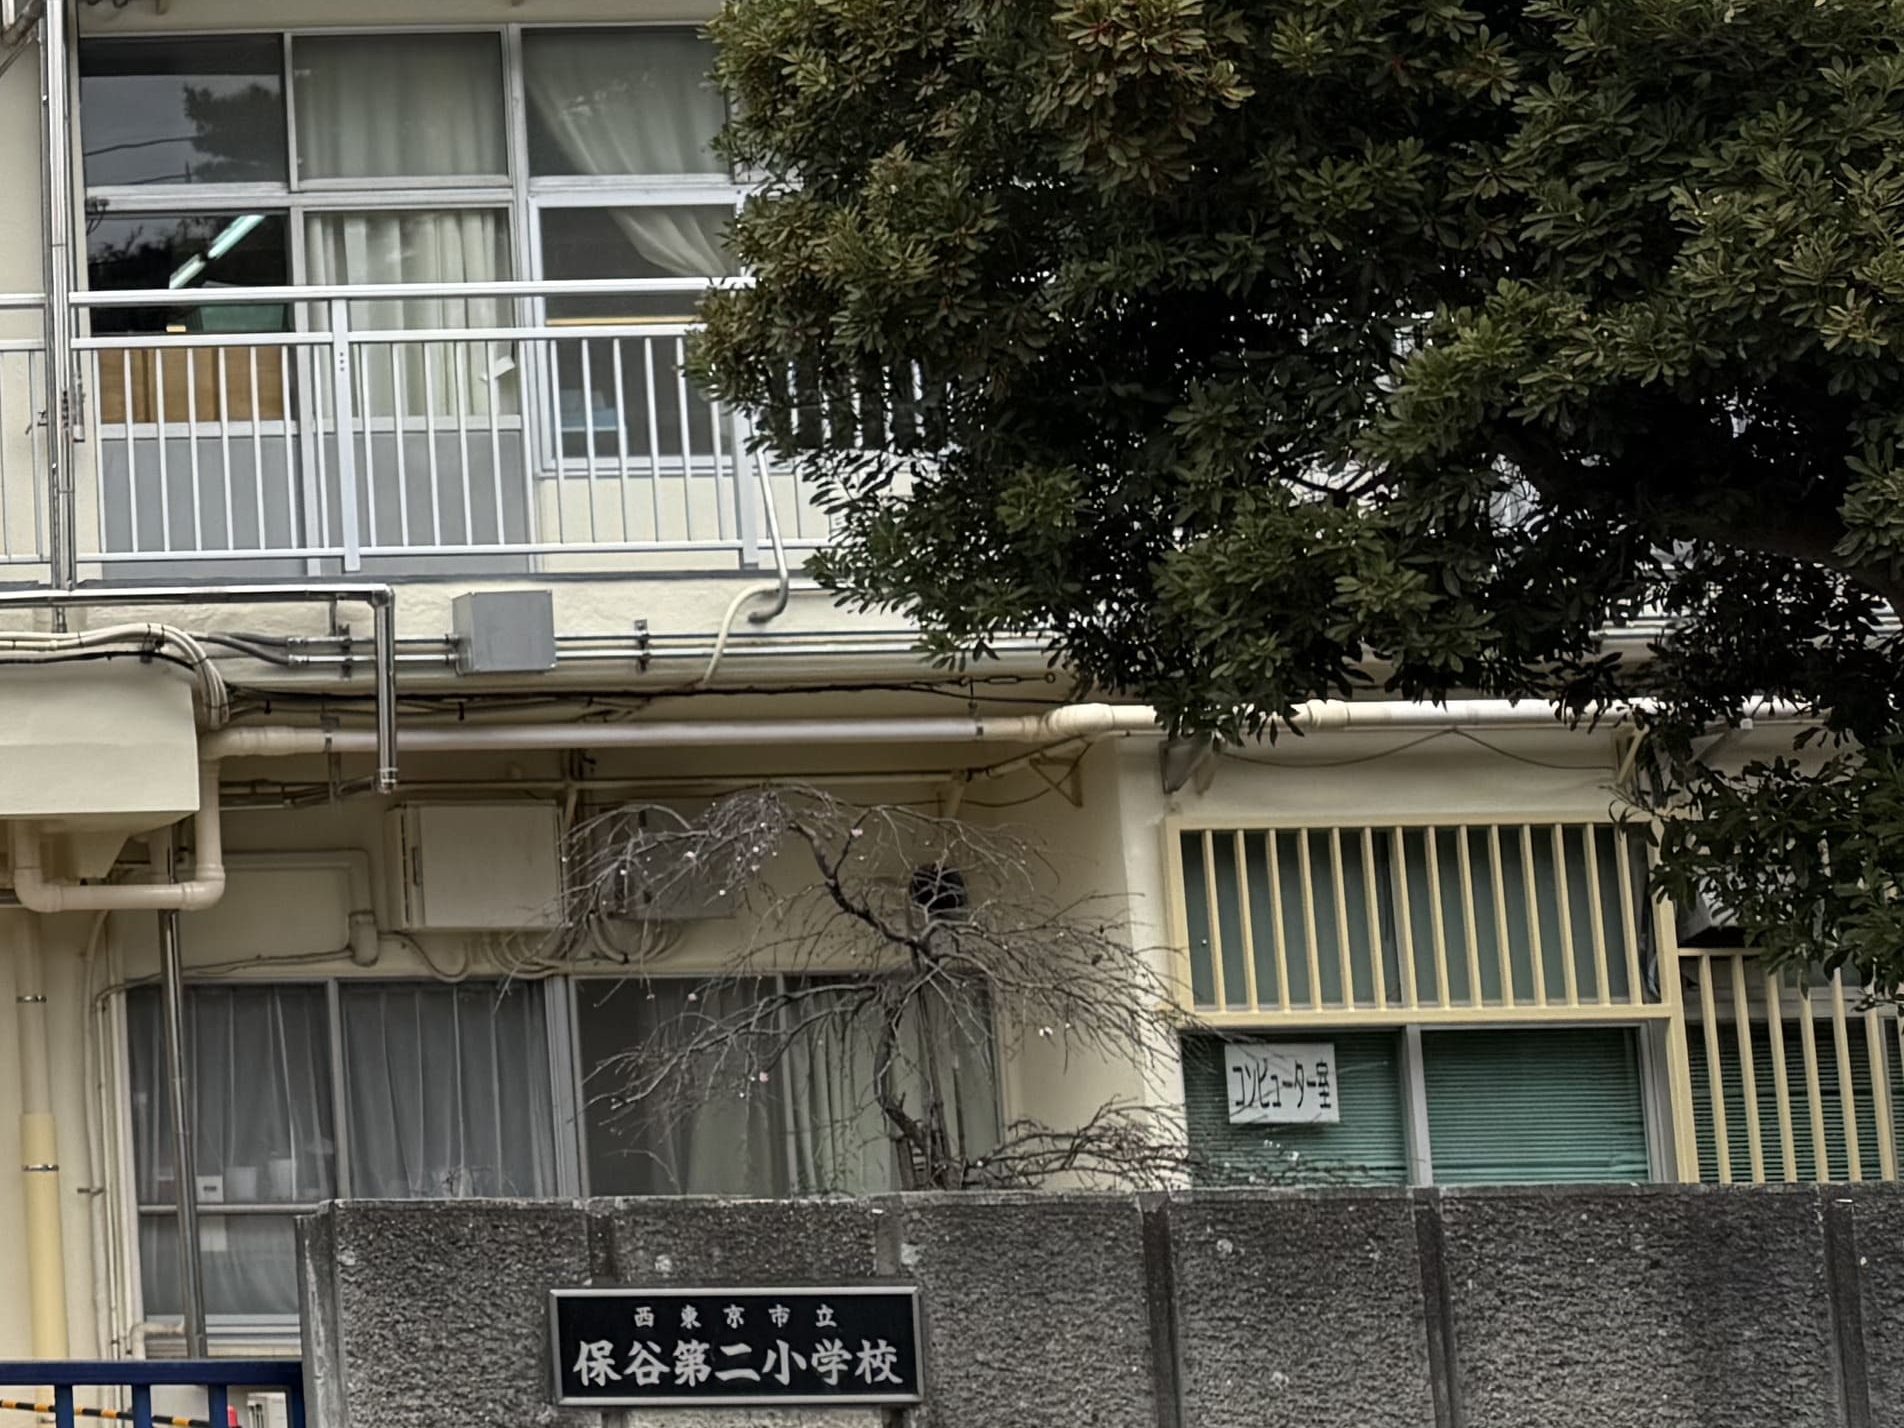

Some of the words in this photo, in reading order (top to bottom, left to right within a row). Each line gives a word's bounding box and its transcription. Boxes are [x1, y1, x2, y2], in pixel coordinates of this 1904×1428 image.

[634, 1304, 838, 1329] 西東京市立
[573, 1338, 903, 1388] 保谷第二小学校
